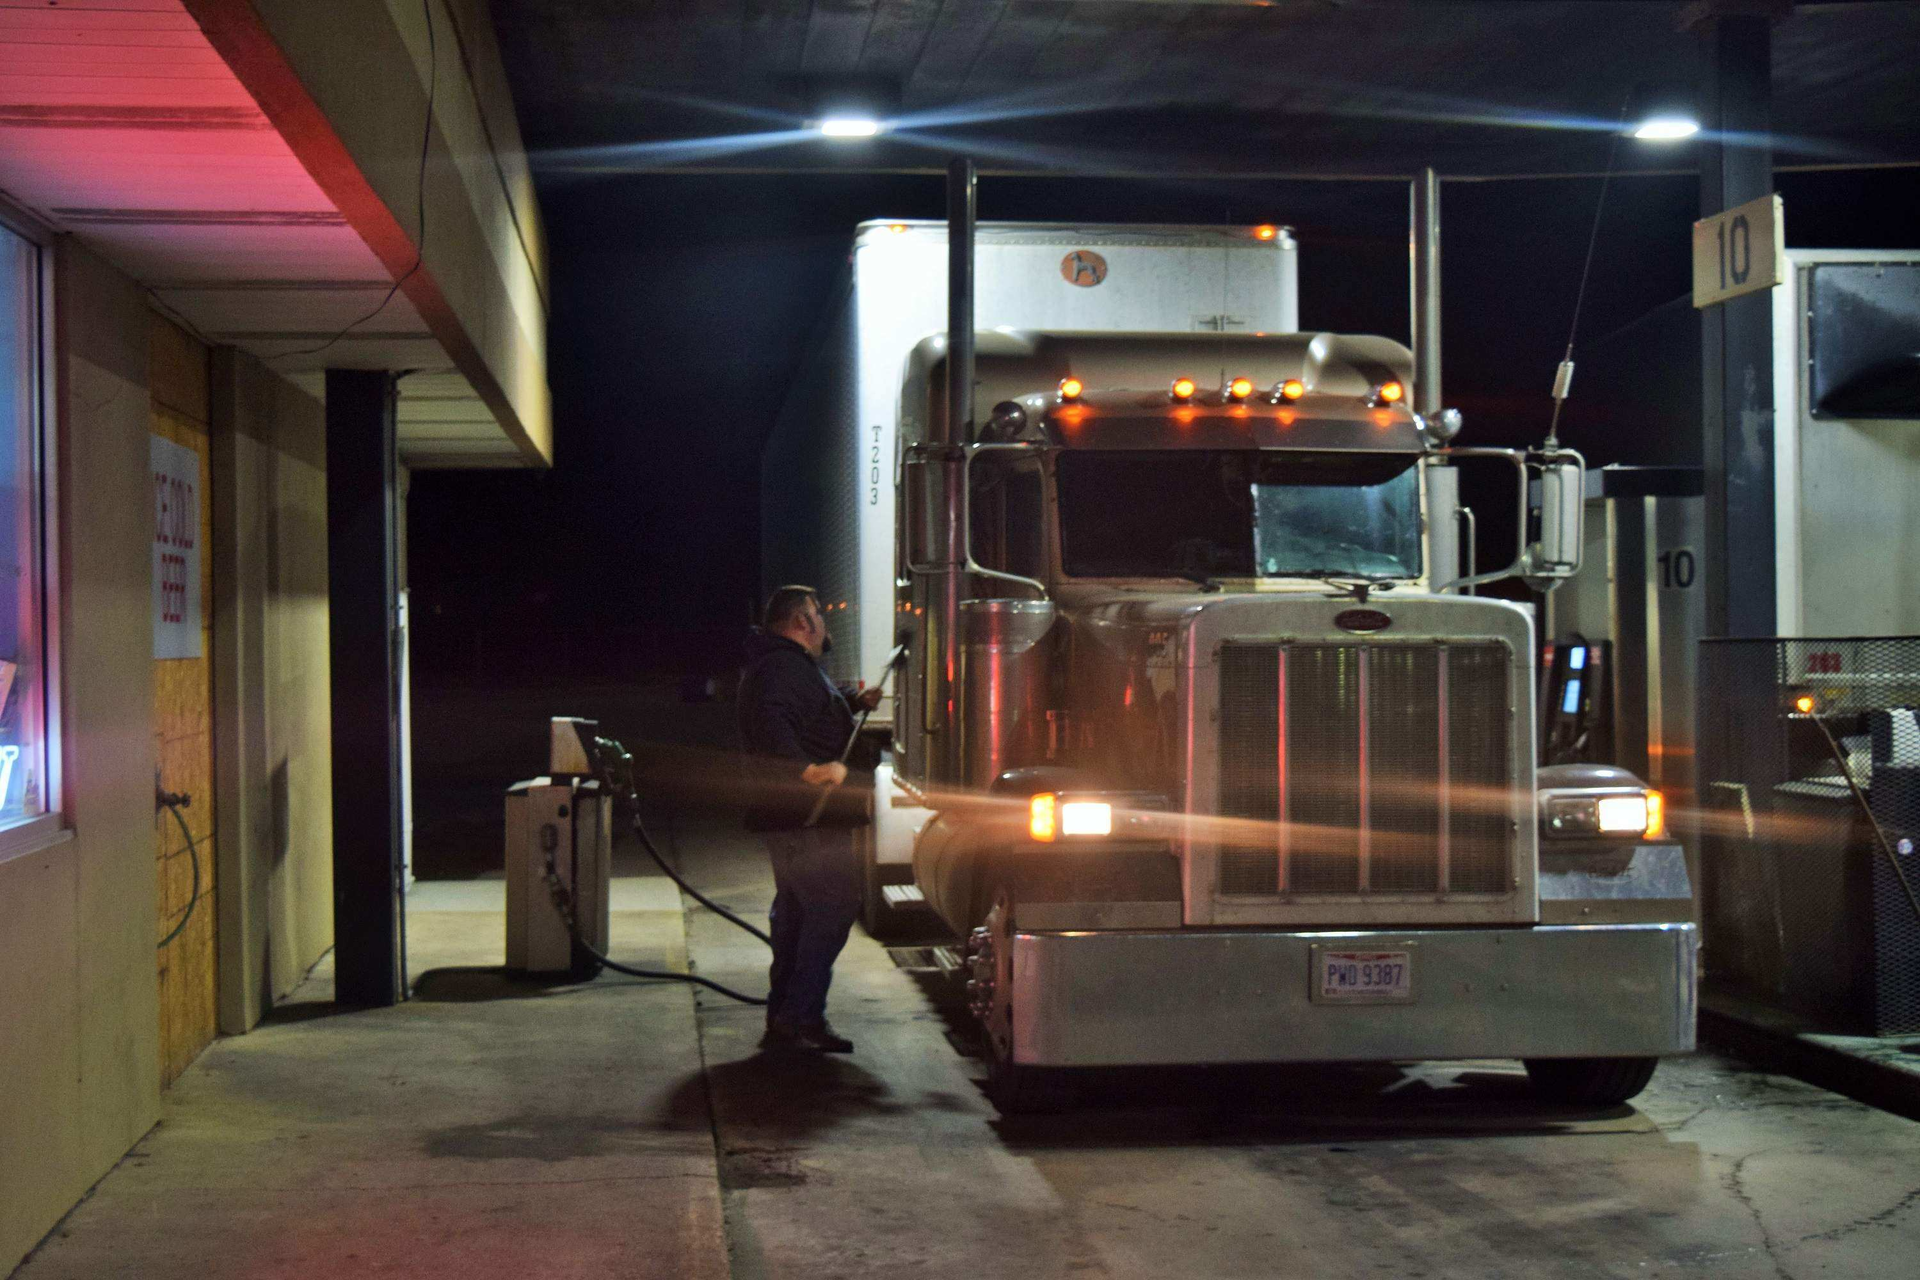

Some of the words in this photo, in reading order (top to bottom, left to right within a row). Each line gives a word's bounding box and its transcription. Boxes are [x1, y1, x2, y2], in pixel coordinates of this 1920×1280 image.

[1717, 214, 1750, 290] 10
[870, 426, 882, 505] T203
[1658, 550, 1694, 588] 10
[1362, 964, 1403, 986] 9387
